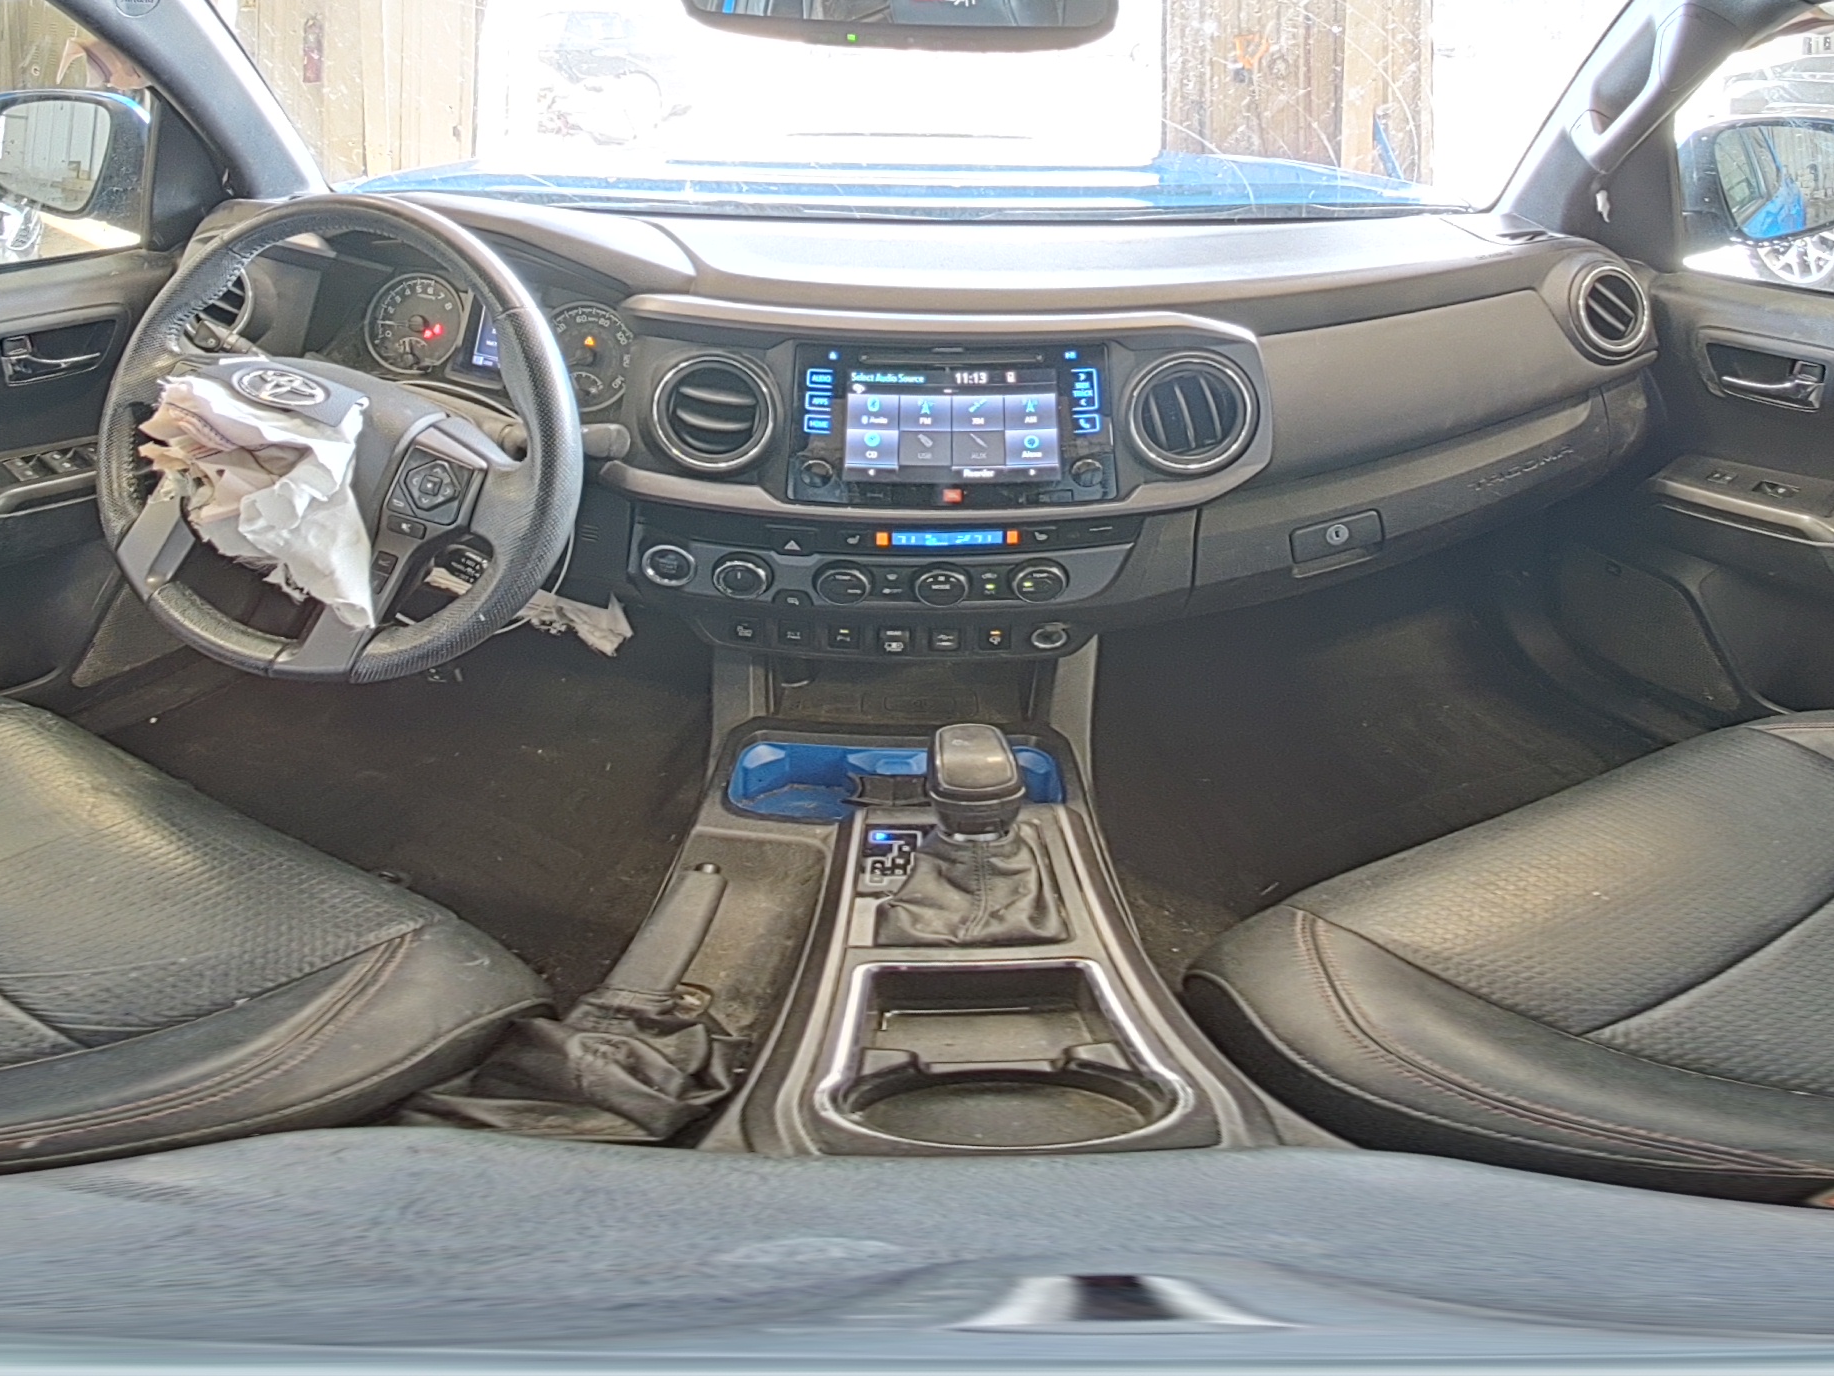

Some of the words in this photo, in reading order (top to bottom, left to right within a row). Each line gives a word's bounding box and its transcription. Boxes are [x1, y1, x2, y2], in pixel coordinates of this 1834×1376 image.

[576, 315, 587, 323] 60
[851, 372, 874, 382] Select
[875, 373, 897, 383] Audio
[898, 374, 925, 383] Source
[955, 372, 987, 384] 11:13
[919, 417, 932, 425] FM
[866, 450, 878, 459] CD
